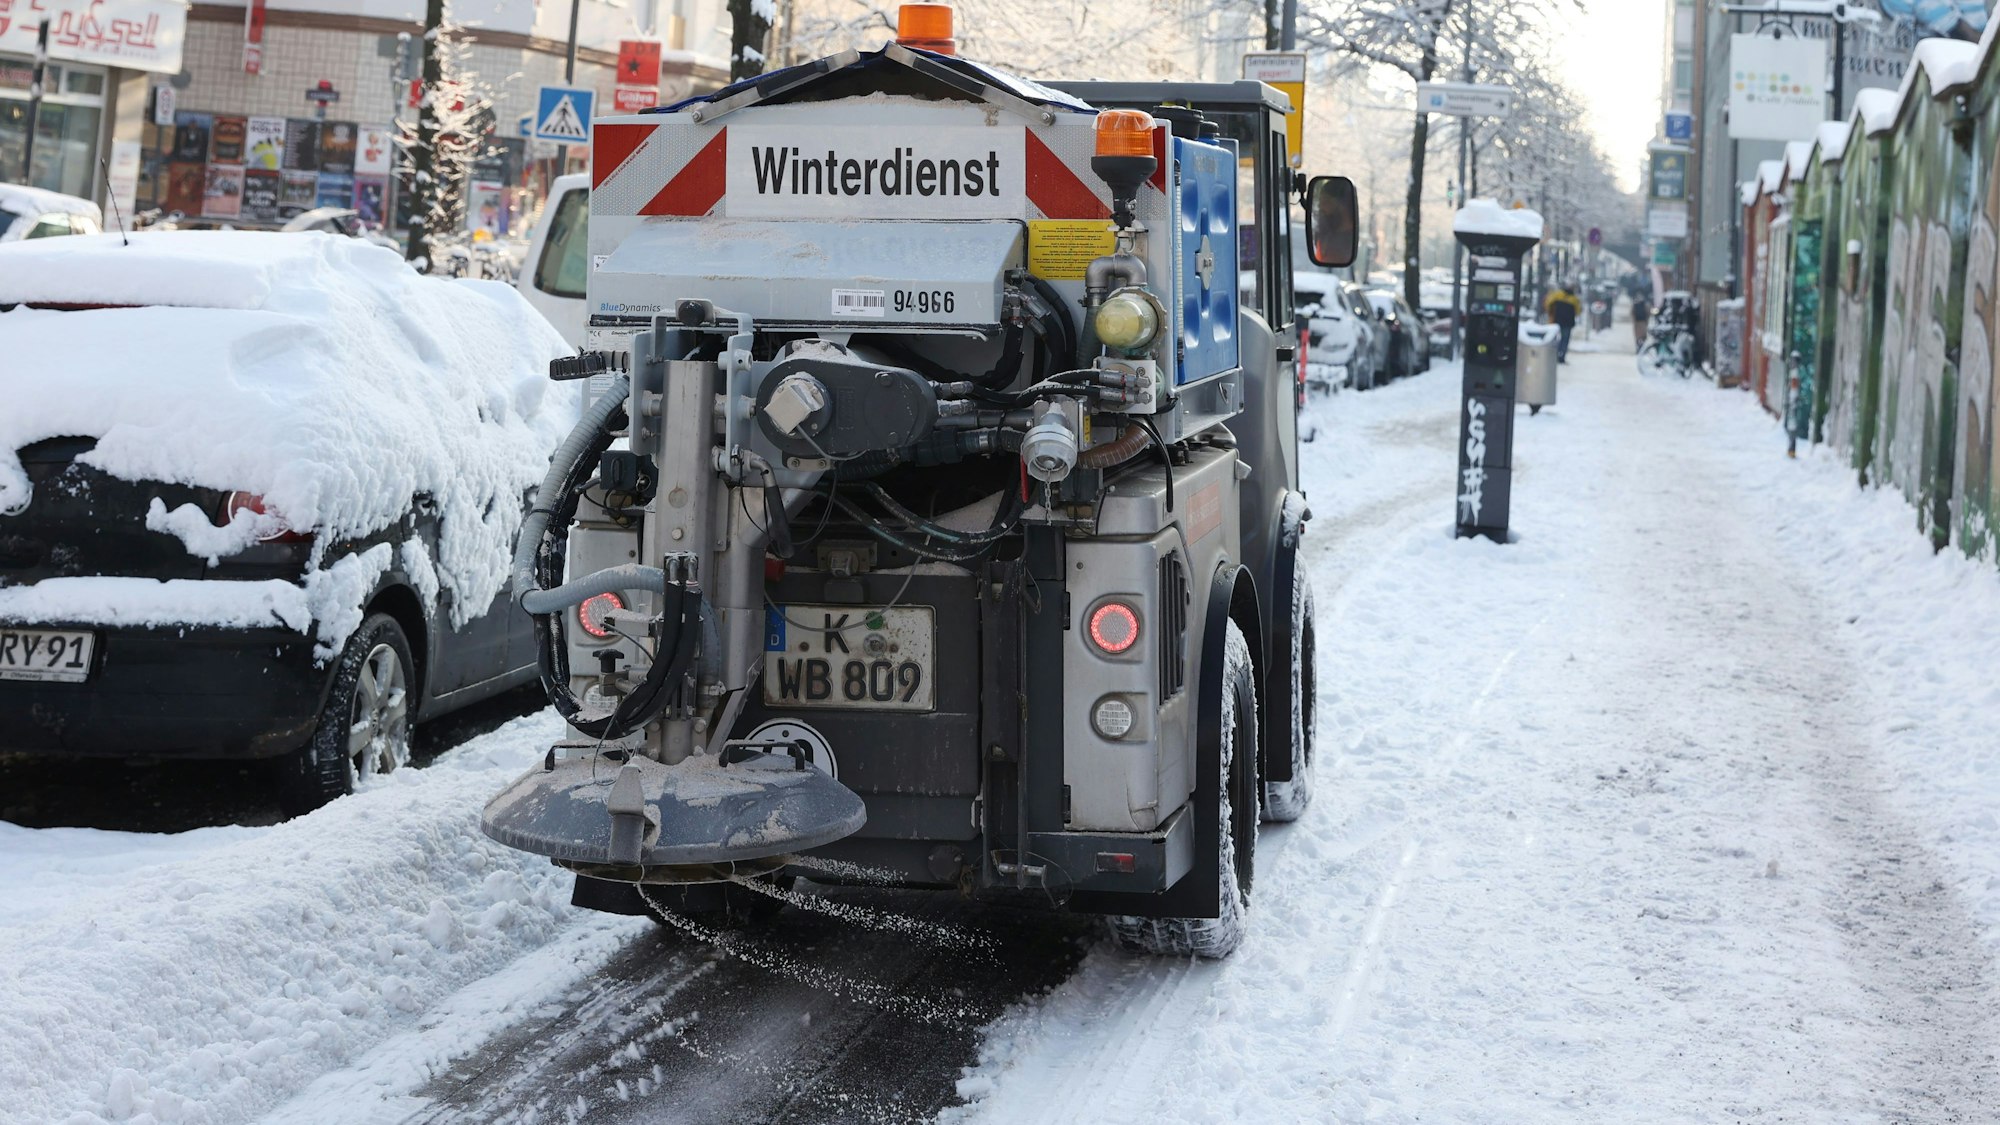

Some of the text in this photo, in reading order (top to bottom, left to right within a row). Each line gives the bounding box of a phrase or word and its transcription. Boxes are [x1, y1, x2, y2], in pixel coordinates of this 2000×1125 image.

[752, 146, 1000, 196] Winterdienst
[600, 302, 661, 314] BlueDynamics
[894, 289, 955, 314] 94966
[0, 633, 84, 669] RY 91
[770, 633, 780, 646] D
[824, 613, 850, 654] K
[778, 658, 921, 703] WB 809
